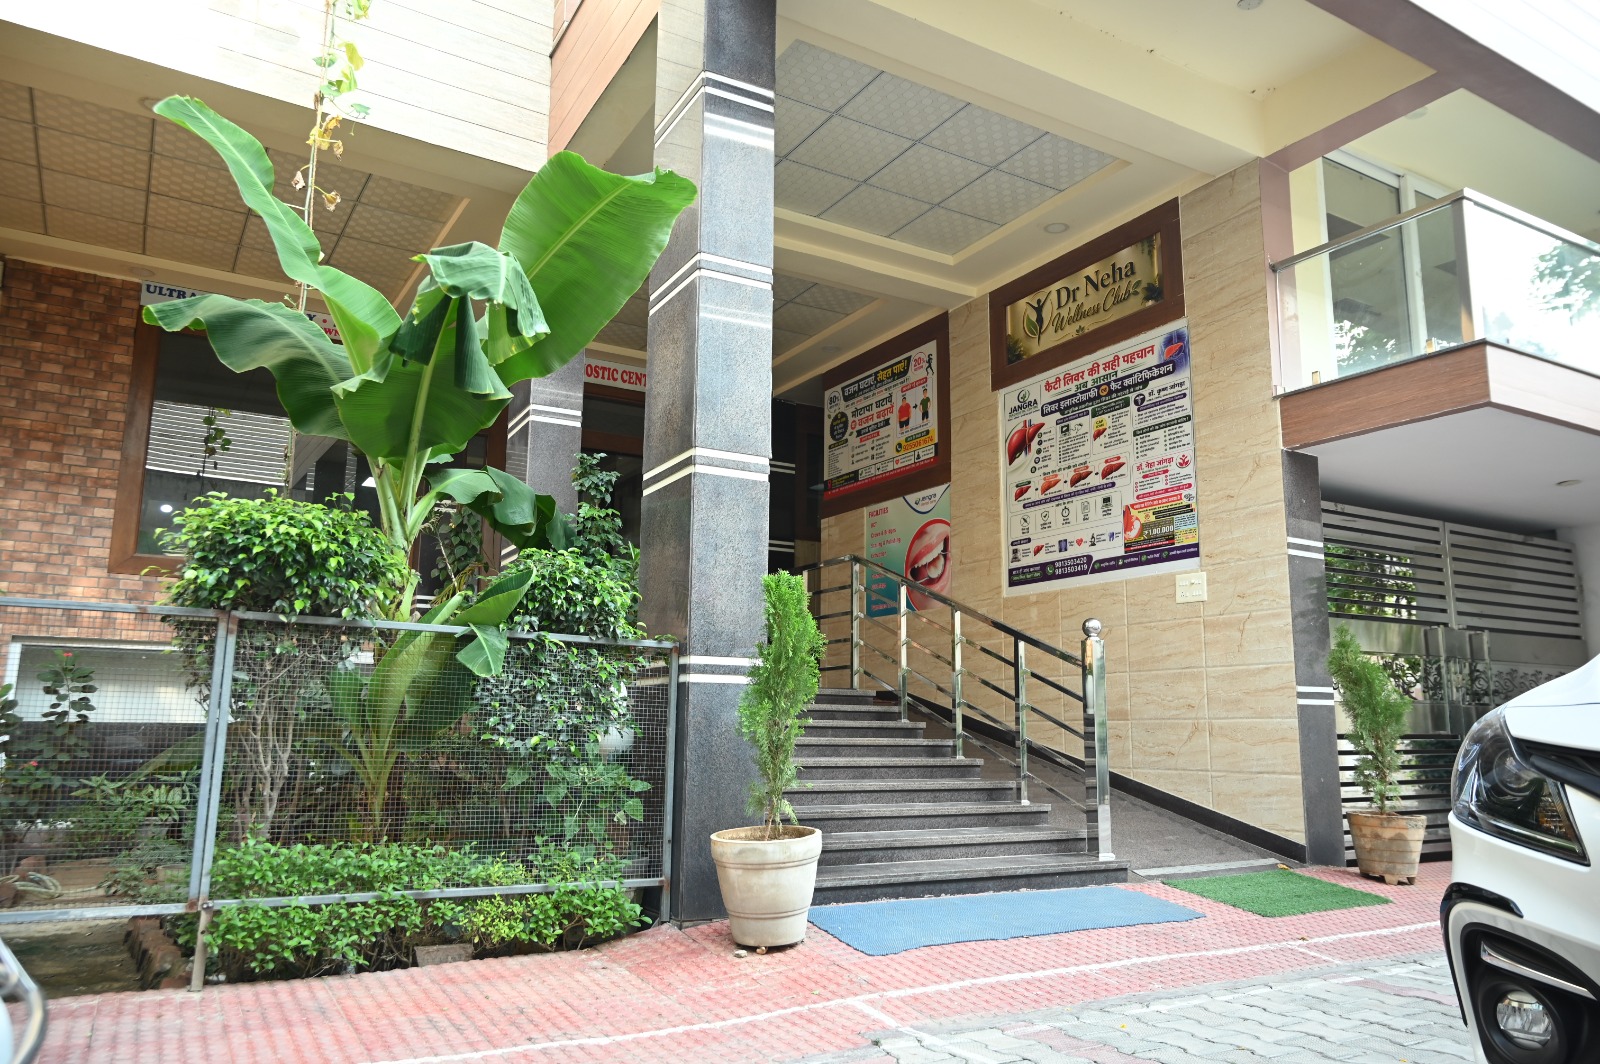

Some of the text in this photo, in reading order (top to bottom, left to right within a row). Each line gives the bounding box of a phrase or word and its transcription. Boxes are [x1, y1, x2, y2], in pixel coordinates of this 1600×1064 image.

[1056, 261, 1136, 310] Dr Neha
[1052, 281, 1131, 334] Wellness Club
[585, 364, 619, 382] OSTIC
[1044, 344, 1156, 393] फैटी लिवर की सही पहचान
[844, 385, 858, 396] वजन
[877, 367, 892, 381] सेहत
[1043, 402, 1059, 415] लिवर
[1060, 387, 1098, 410] इलास्टोग्राफी
[1110, 380, 1122, 391] फैट
[1123, 362, 1173, 386] क्वांटिफिकेशन
[1074, 370, 1118, 393] अब आसान
[851, 403, 873, 419] मोटापा
[1009, 399, 1038, 415] JANGRA
[858, 413, 874, 427] वजन
[868, 507, 889, 518] FACILITIES
[1054, 557, 1087, 568] 9813503420
[1054, 565, 1088, 575] 9813503419
